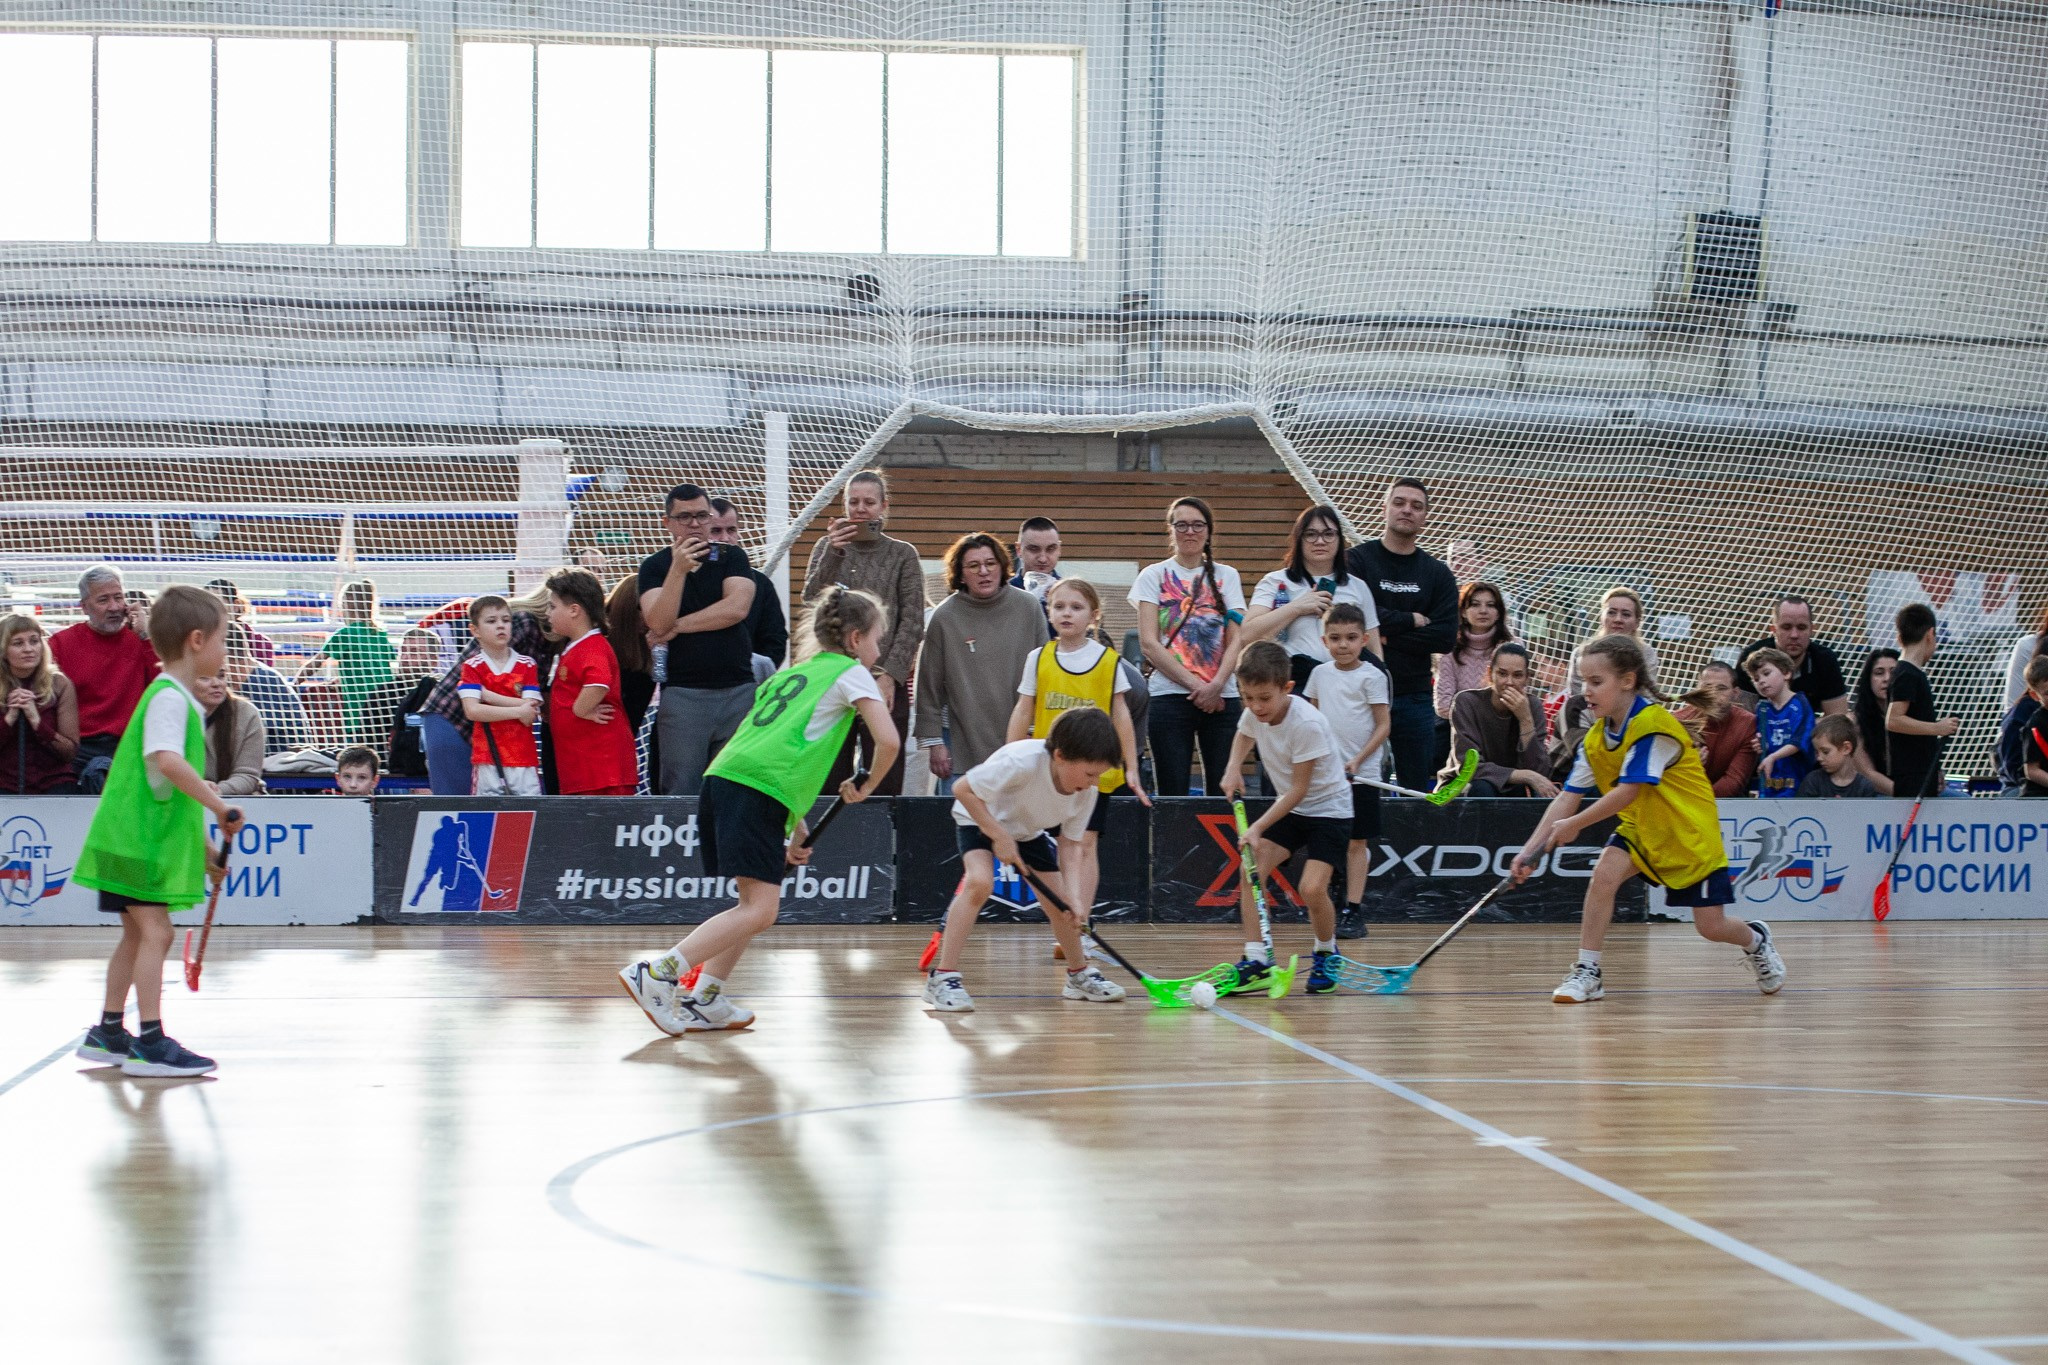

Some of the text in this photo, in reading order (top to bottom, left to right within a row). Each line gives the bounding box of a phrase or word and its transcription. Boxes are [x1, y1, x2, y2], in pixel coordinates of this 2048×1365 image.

[21, 845, 53, 859] ЛЕТ
[1366, 844, 1603, 878] XDOG
[1803, 845, 1833, 858] ЛЕТ
[555, 864, 870, 901] #russiaflrball
[1892, 862, 2032, 893] РОССИИ
